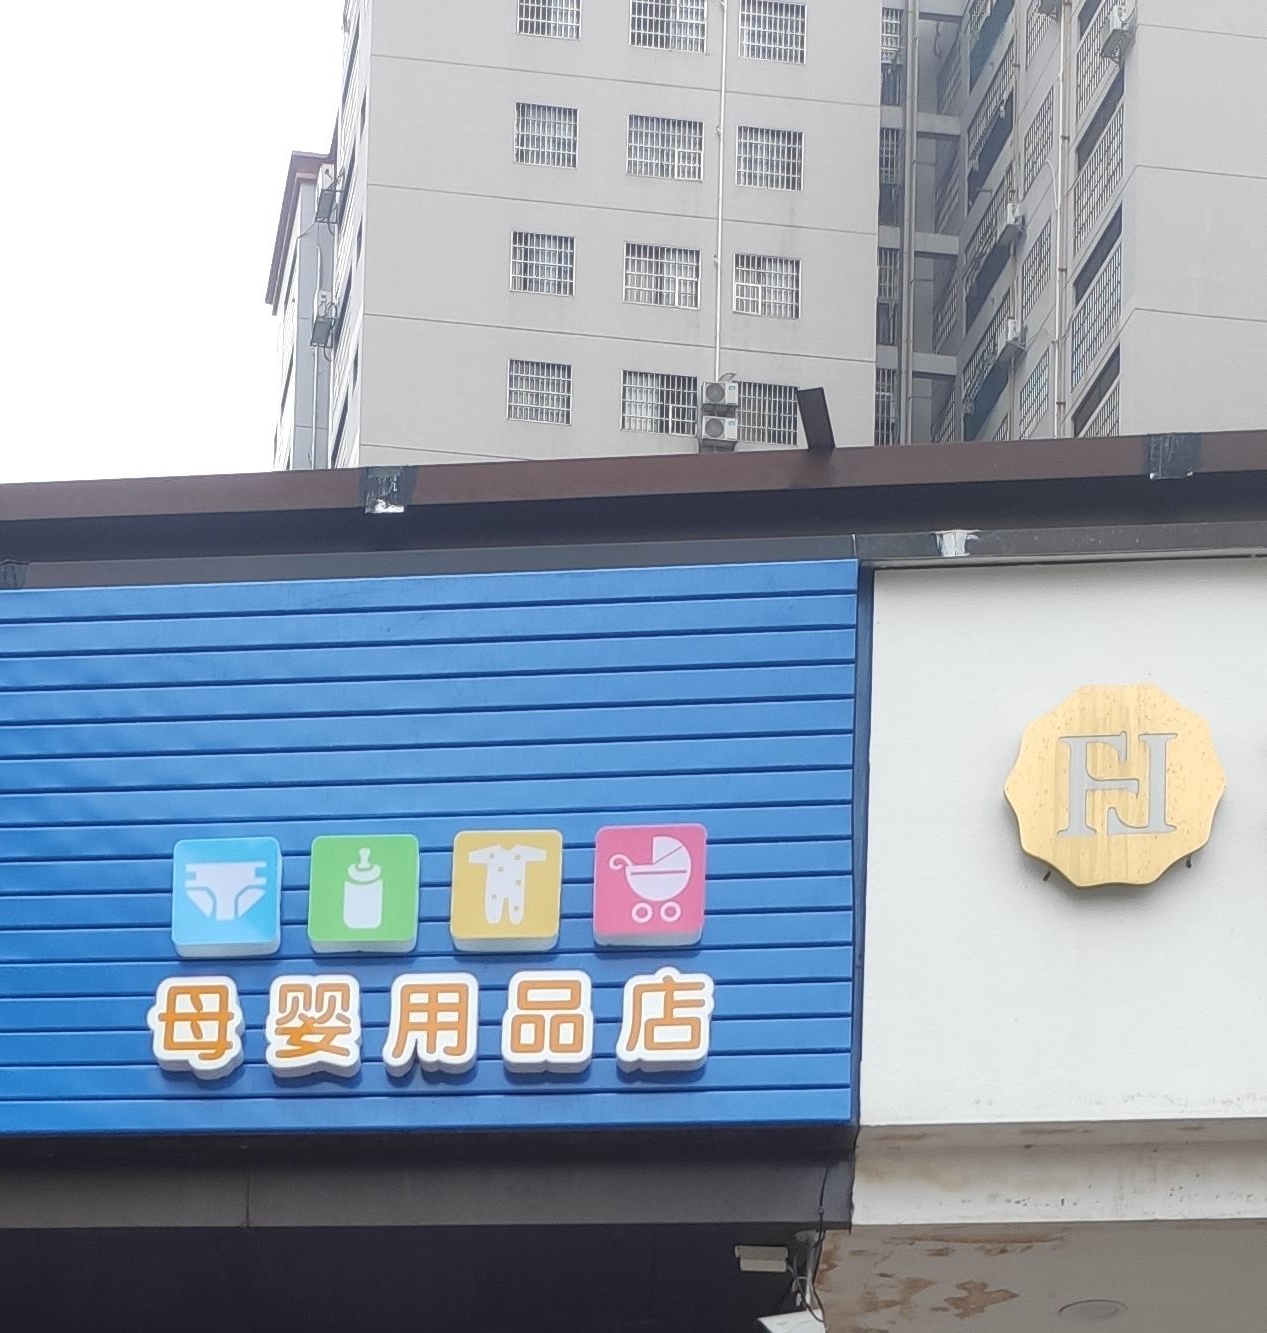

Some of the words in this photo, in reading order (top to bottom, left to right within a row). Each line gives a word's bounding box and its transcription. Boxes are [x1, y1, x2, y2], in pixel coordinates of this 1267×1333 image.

[147, 967, 714, 1079] 母婴用品店
